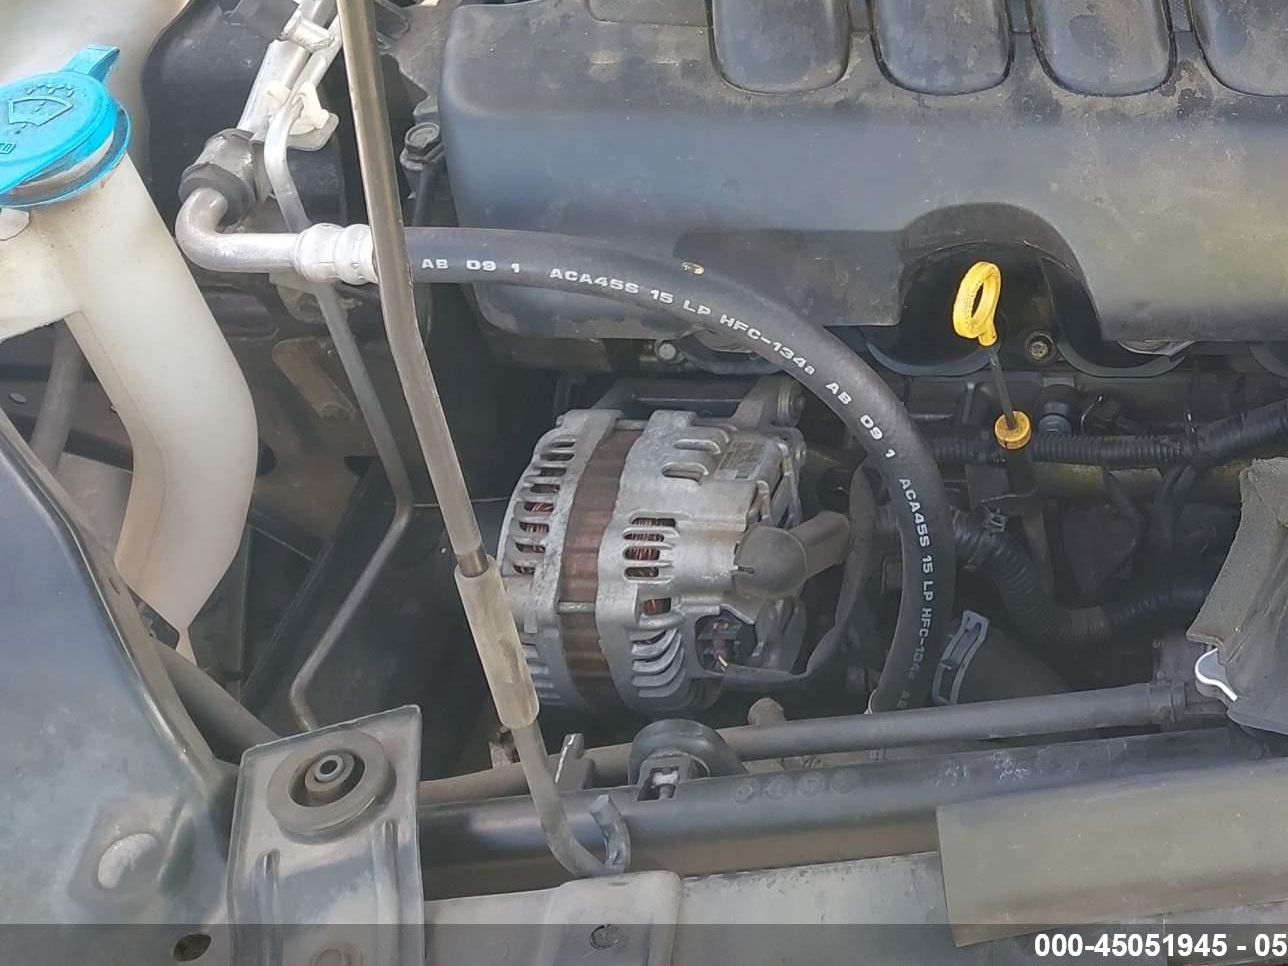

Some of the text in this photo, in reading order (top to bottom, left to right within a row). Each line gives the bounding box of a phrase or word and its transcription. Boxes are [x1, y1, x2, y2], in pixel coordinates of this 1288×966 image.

[421, 258, 449, 270] AB
[511, 262, 521, 274] 1
[549, 268, 640, 295] ACA45S
[650, 288, 675, 304] 15
[683, 299, 712, 316] LP
[719, 313, 816, 376] HFC-134a
[825, 381, 853, 406] AB
[899, 477, 931, 547] ACA45S
[921, 554, 934, 575] 15
[922, 580, 935, 601] LP
